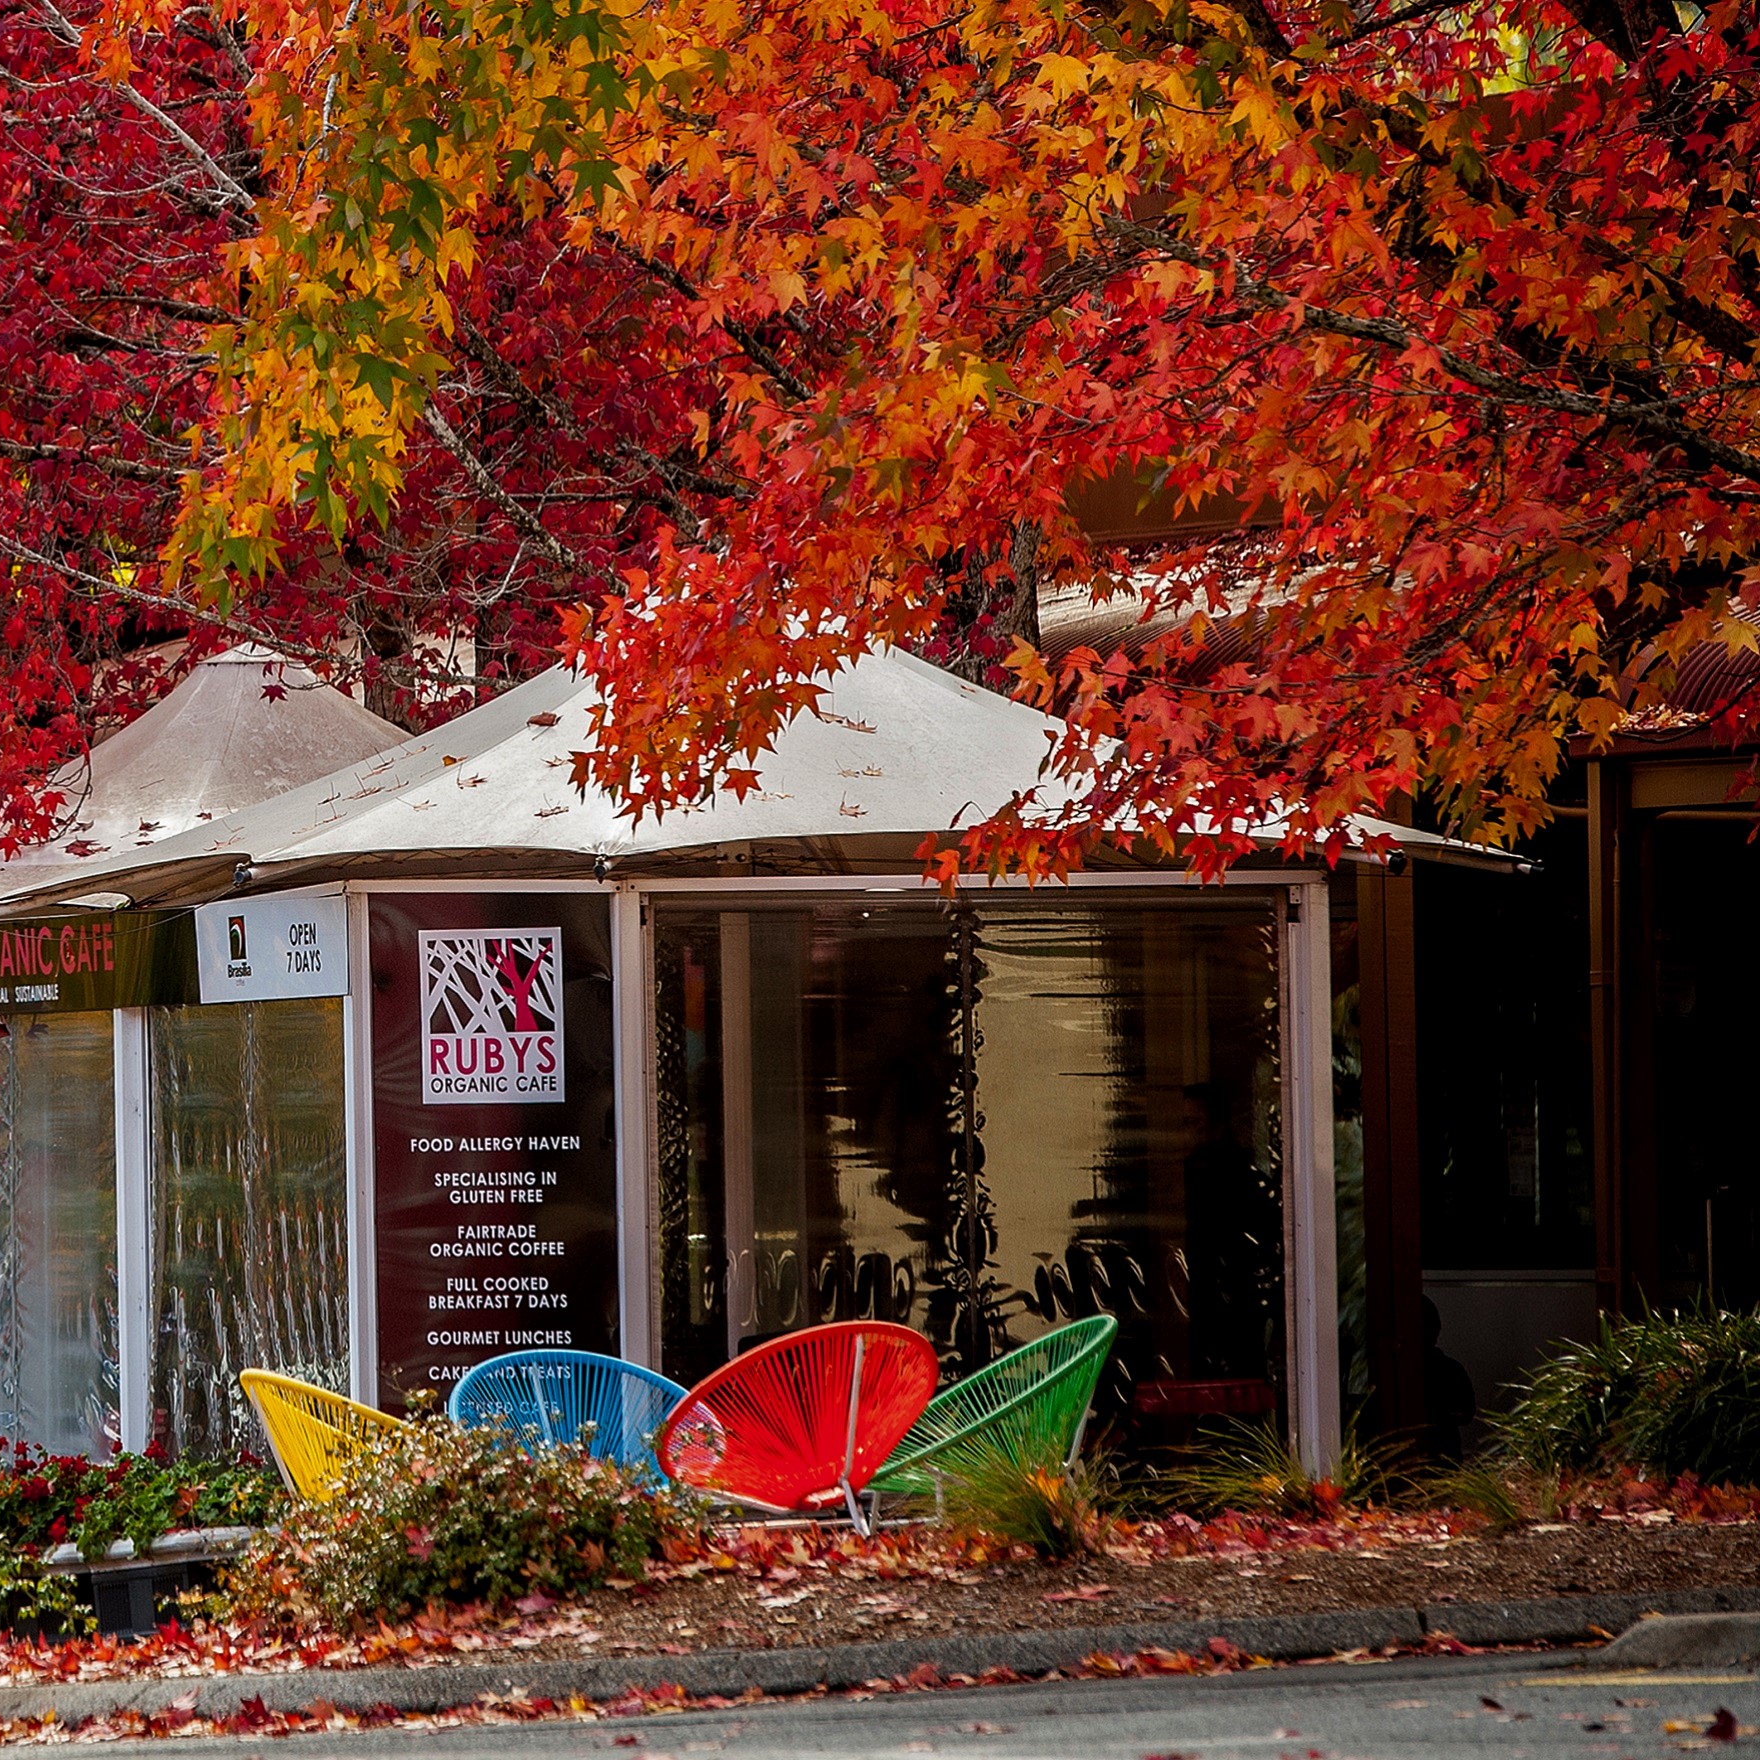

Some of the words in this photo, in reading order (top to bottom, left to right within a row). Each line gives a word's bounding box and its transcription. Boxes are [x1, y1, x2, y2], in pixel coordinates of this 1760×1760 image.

[288, 922, 317, 947] OPEN
[60, 923, 115, 972] CAFE
[286, 951, 294, 974] 7
[295, 949, 322, 973] DAYS
[15, 984, 59, 1003] SUSTAINABLE
[429, 1036, 557, 1076] RUBYS
[430, 1076, 508, 1095] ORGANIC
[516, 1075, 557, 1094] CAFE
[410, 1138, 453, 1152] FOOD
[459, 1137, 523, 1151] ALLERGY
[528, 1136, 581, 1150] HAVEN
[434, 1172, 536, 1187] SPECIALISING
[541, 1171, 557, 1186] IN
[449, 1190, 505, 1204] GLUTEN
[510, 1189, 543, 1203] FREE
[457, 1225, 536, 1239] FAIRTRADE
[430, 1243, 503, 1257] ORGANIC
[508, 1242, 565, 1256] COFFEE
[446, 1278, 478, 1292] FULL
[483, 1277, 549, 1291] COOKED
[428, 1295, 509, 1309] BREAKFAST
[514, 1295, 523, 1309] 7
[528, 1294, 568, 1308] DAYS
[427, 1331, 500, 1346] GOURMET
[505, 1331, 572, 1345] LUNCHES
[428, 1366, 476, 1381] CAKE
